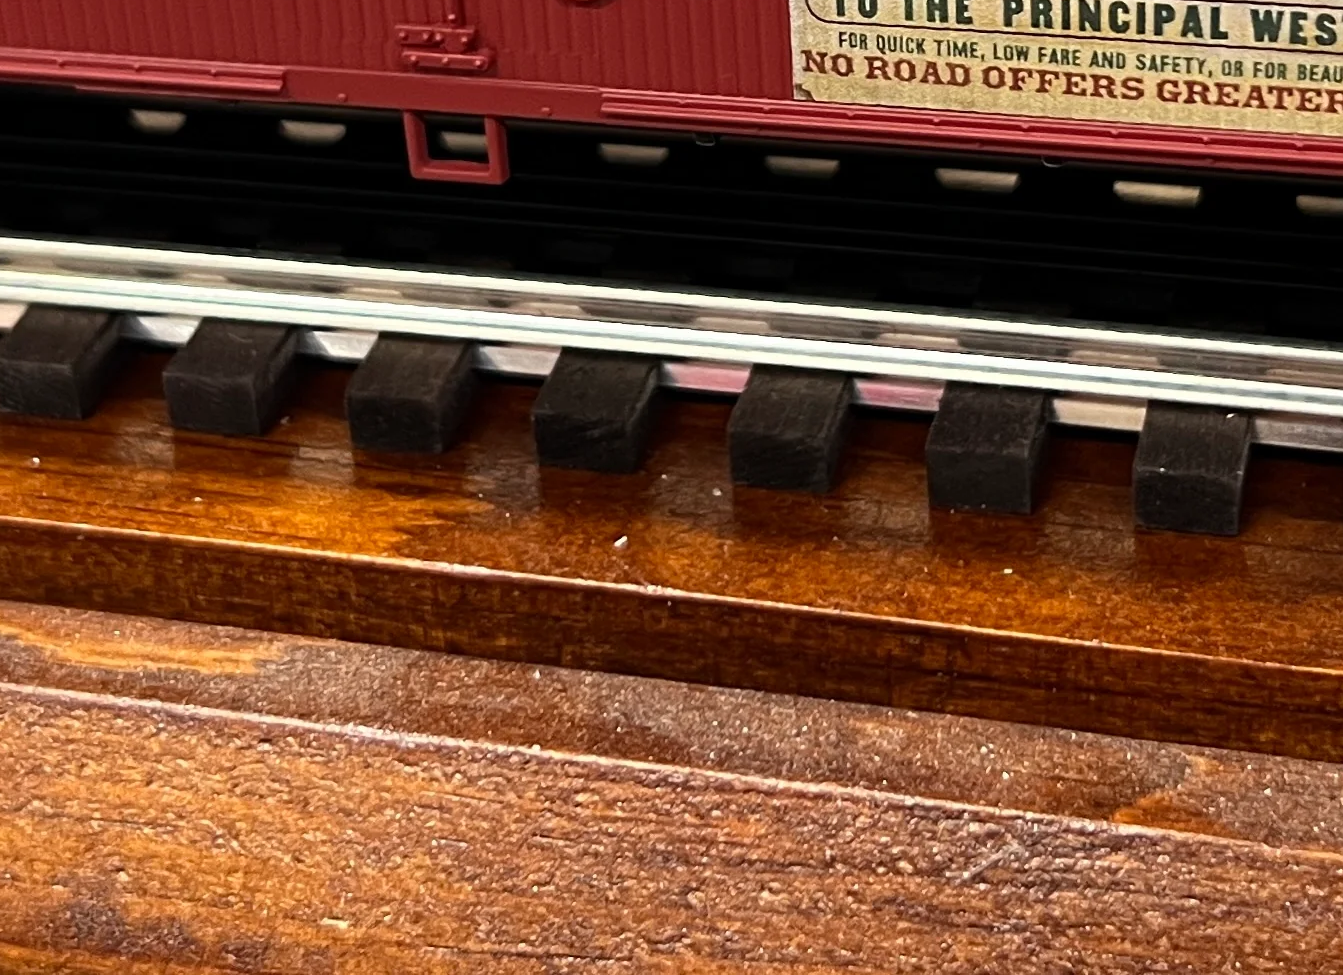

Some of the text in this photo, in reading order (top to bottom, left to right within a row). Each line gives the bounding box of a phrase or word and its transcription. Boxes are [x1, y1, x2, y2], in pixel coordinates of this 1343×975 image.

[801, 50, 855, 77] NO
[864, 56, 972, 88] ROAD
[981, 65, 1145, 101] OFFERS
[838, 31, 869, 50] FOR
[875, 34, 926, 56] QUICK
[933, 39, 986, 62] TIME,
[992, 42, 1030, 63] LOW
[1038, 47, 1081, 67] FARE
[1089, 49, 1127, 70] AND
[1135, 53, 1214, 78] SAFETY,
[1222, 59, 1244, 77] OR
[1252, 61, 1288, 81] FOR
